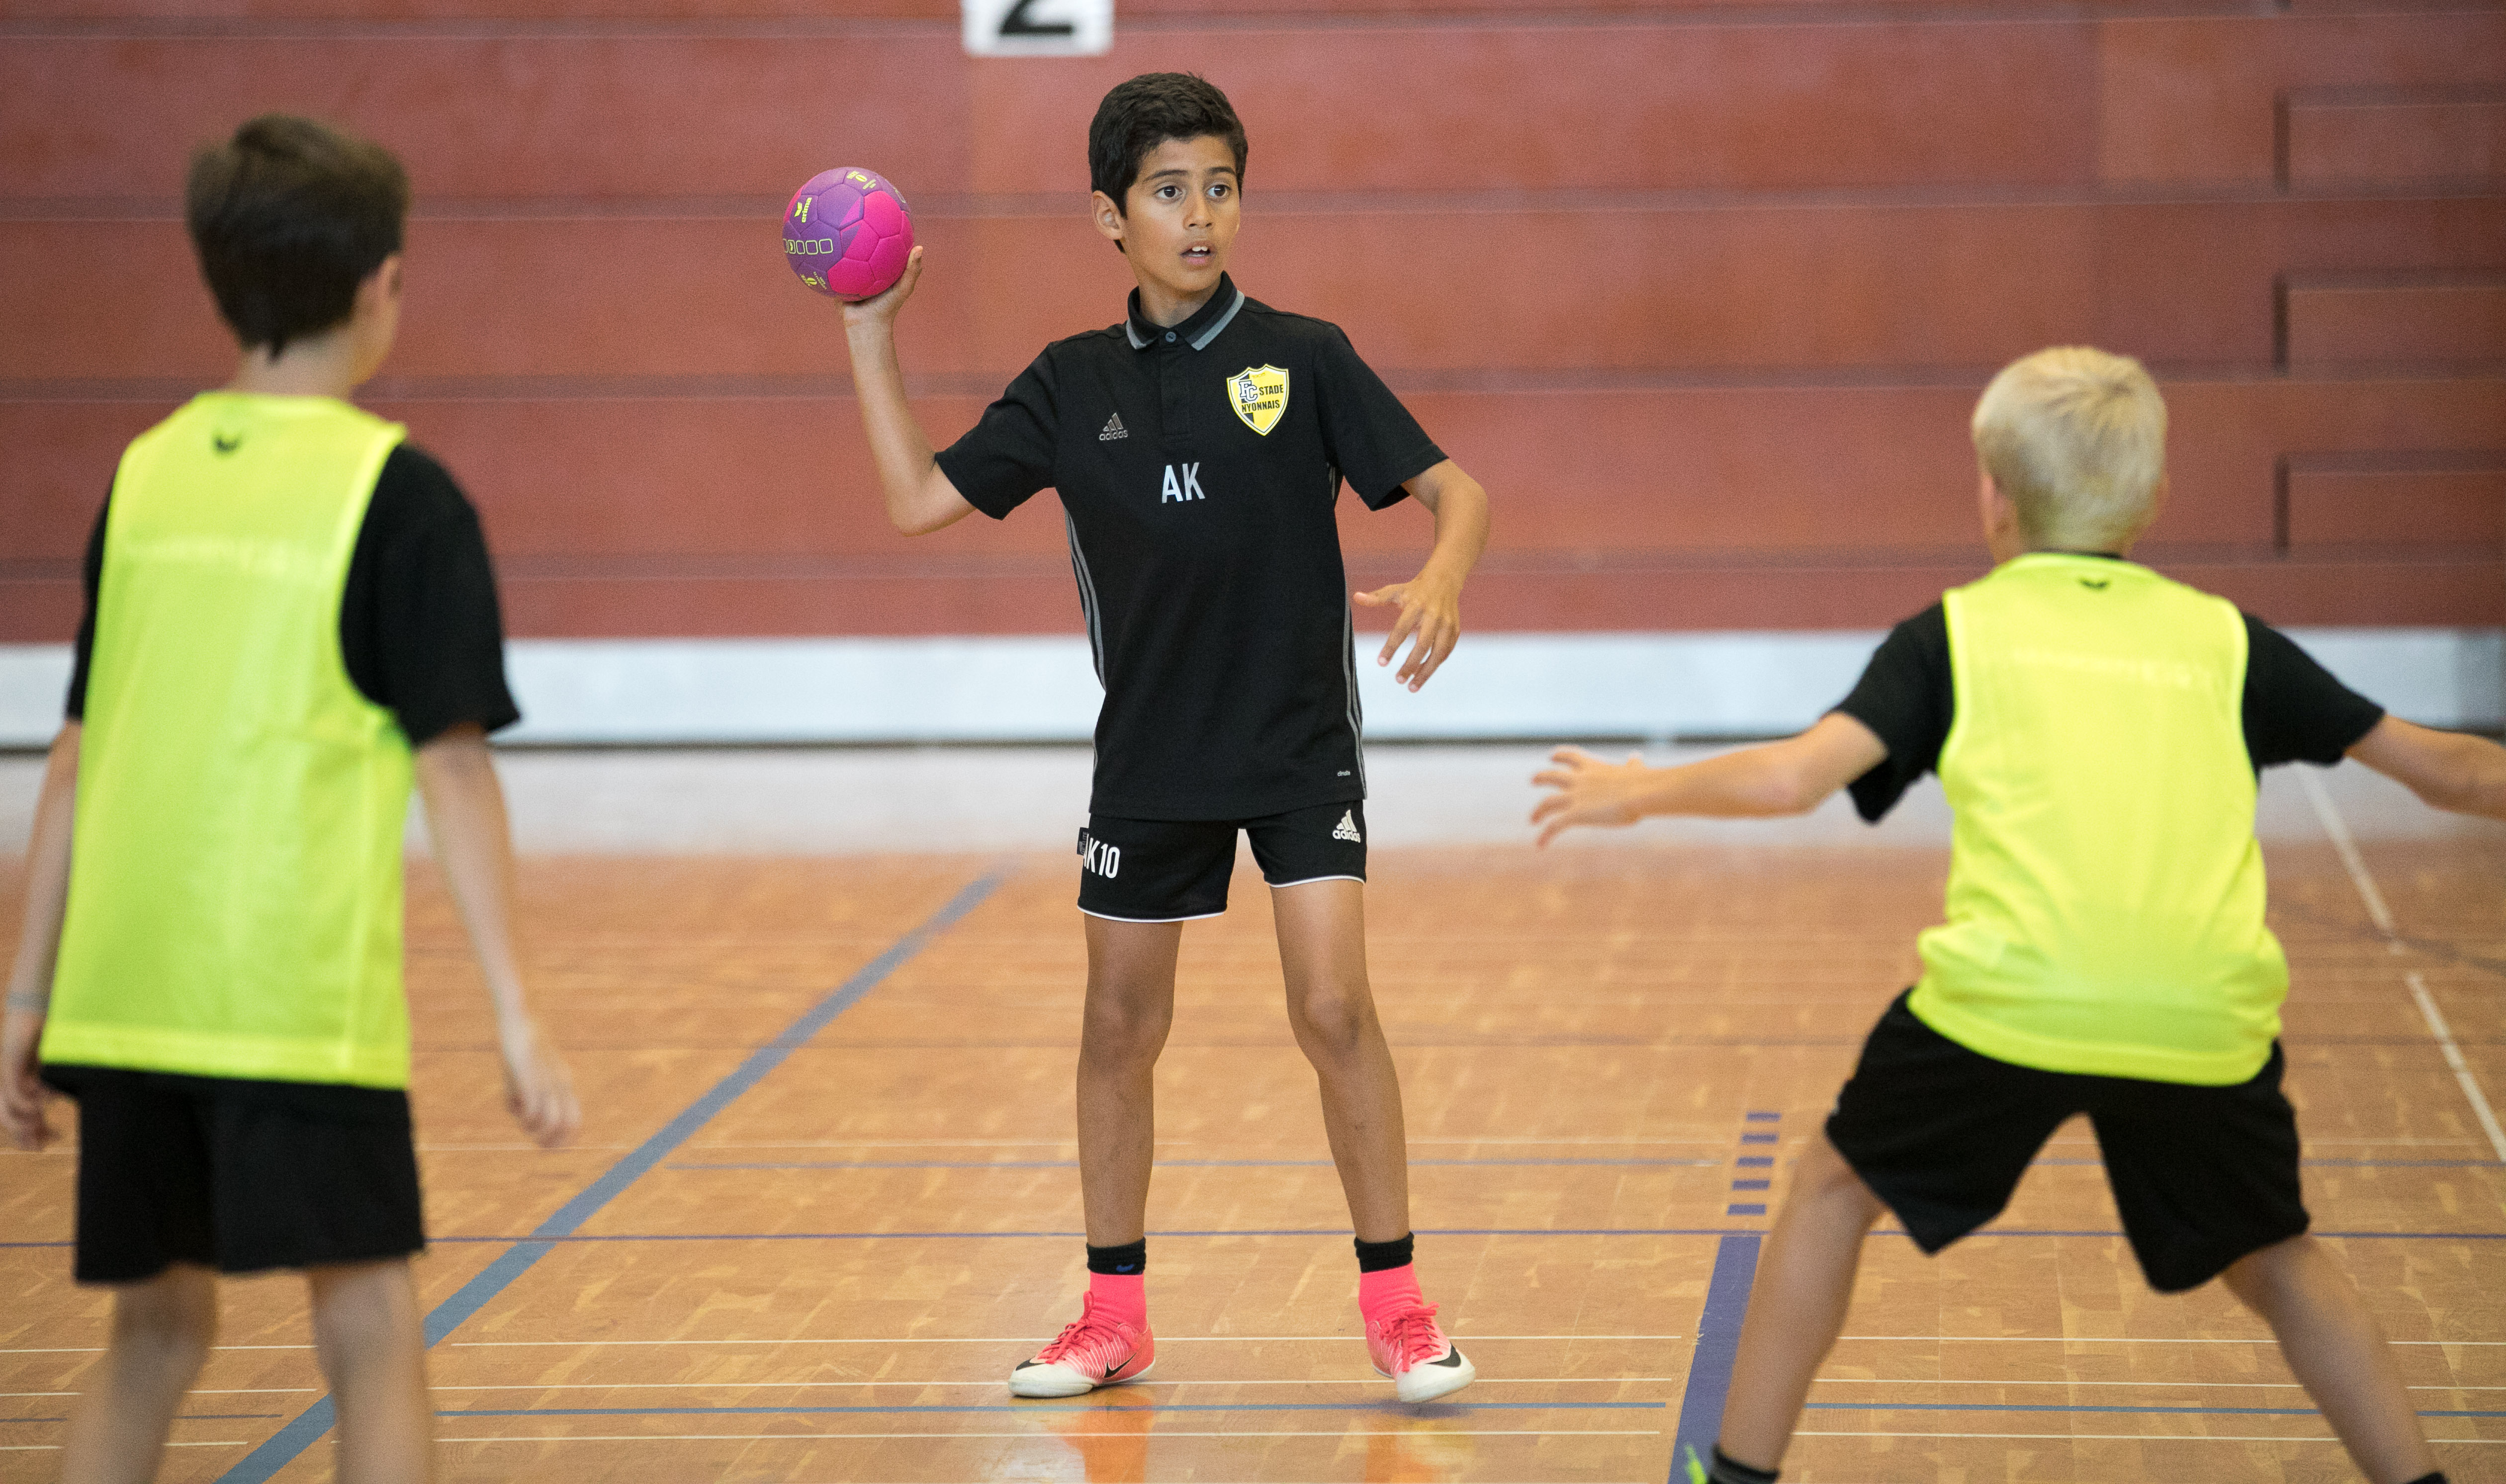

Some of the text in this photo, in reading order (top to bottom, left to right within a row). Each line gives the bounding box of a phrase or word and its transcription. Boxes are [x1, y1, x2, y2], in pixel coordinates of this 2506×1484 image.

[801, 197, 812, 223] erima
[1239, 380, 1284, 402] FC STADE
[1242, 399, 1280, 413] NYONNAIS
[1099, 429, 1128, 441] adidas
[1161, 462, 1206, 504] AK
[1333, 829, 1361, 843] adidas
